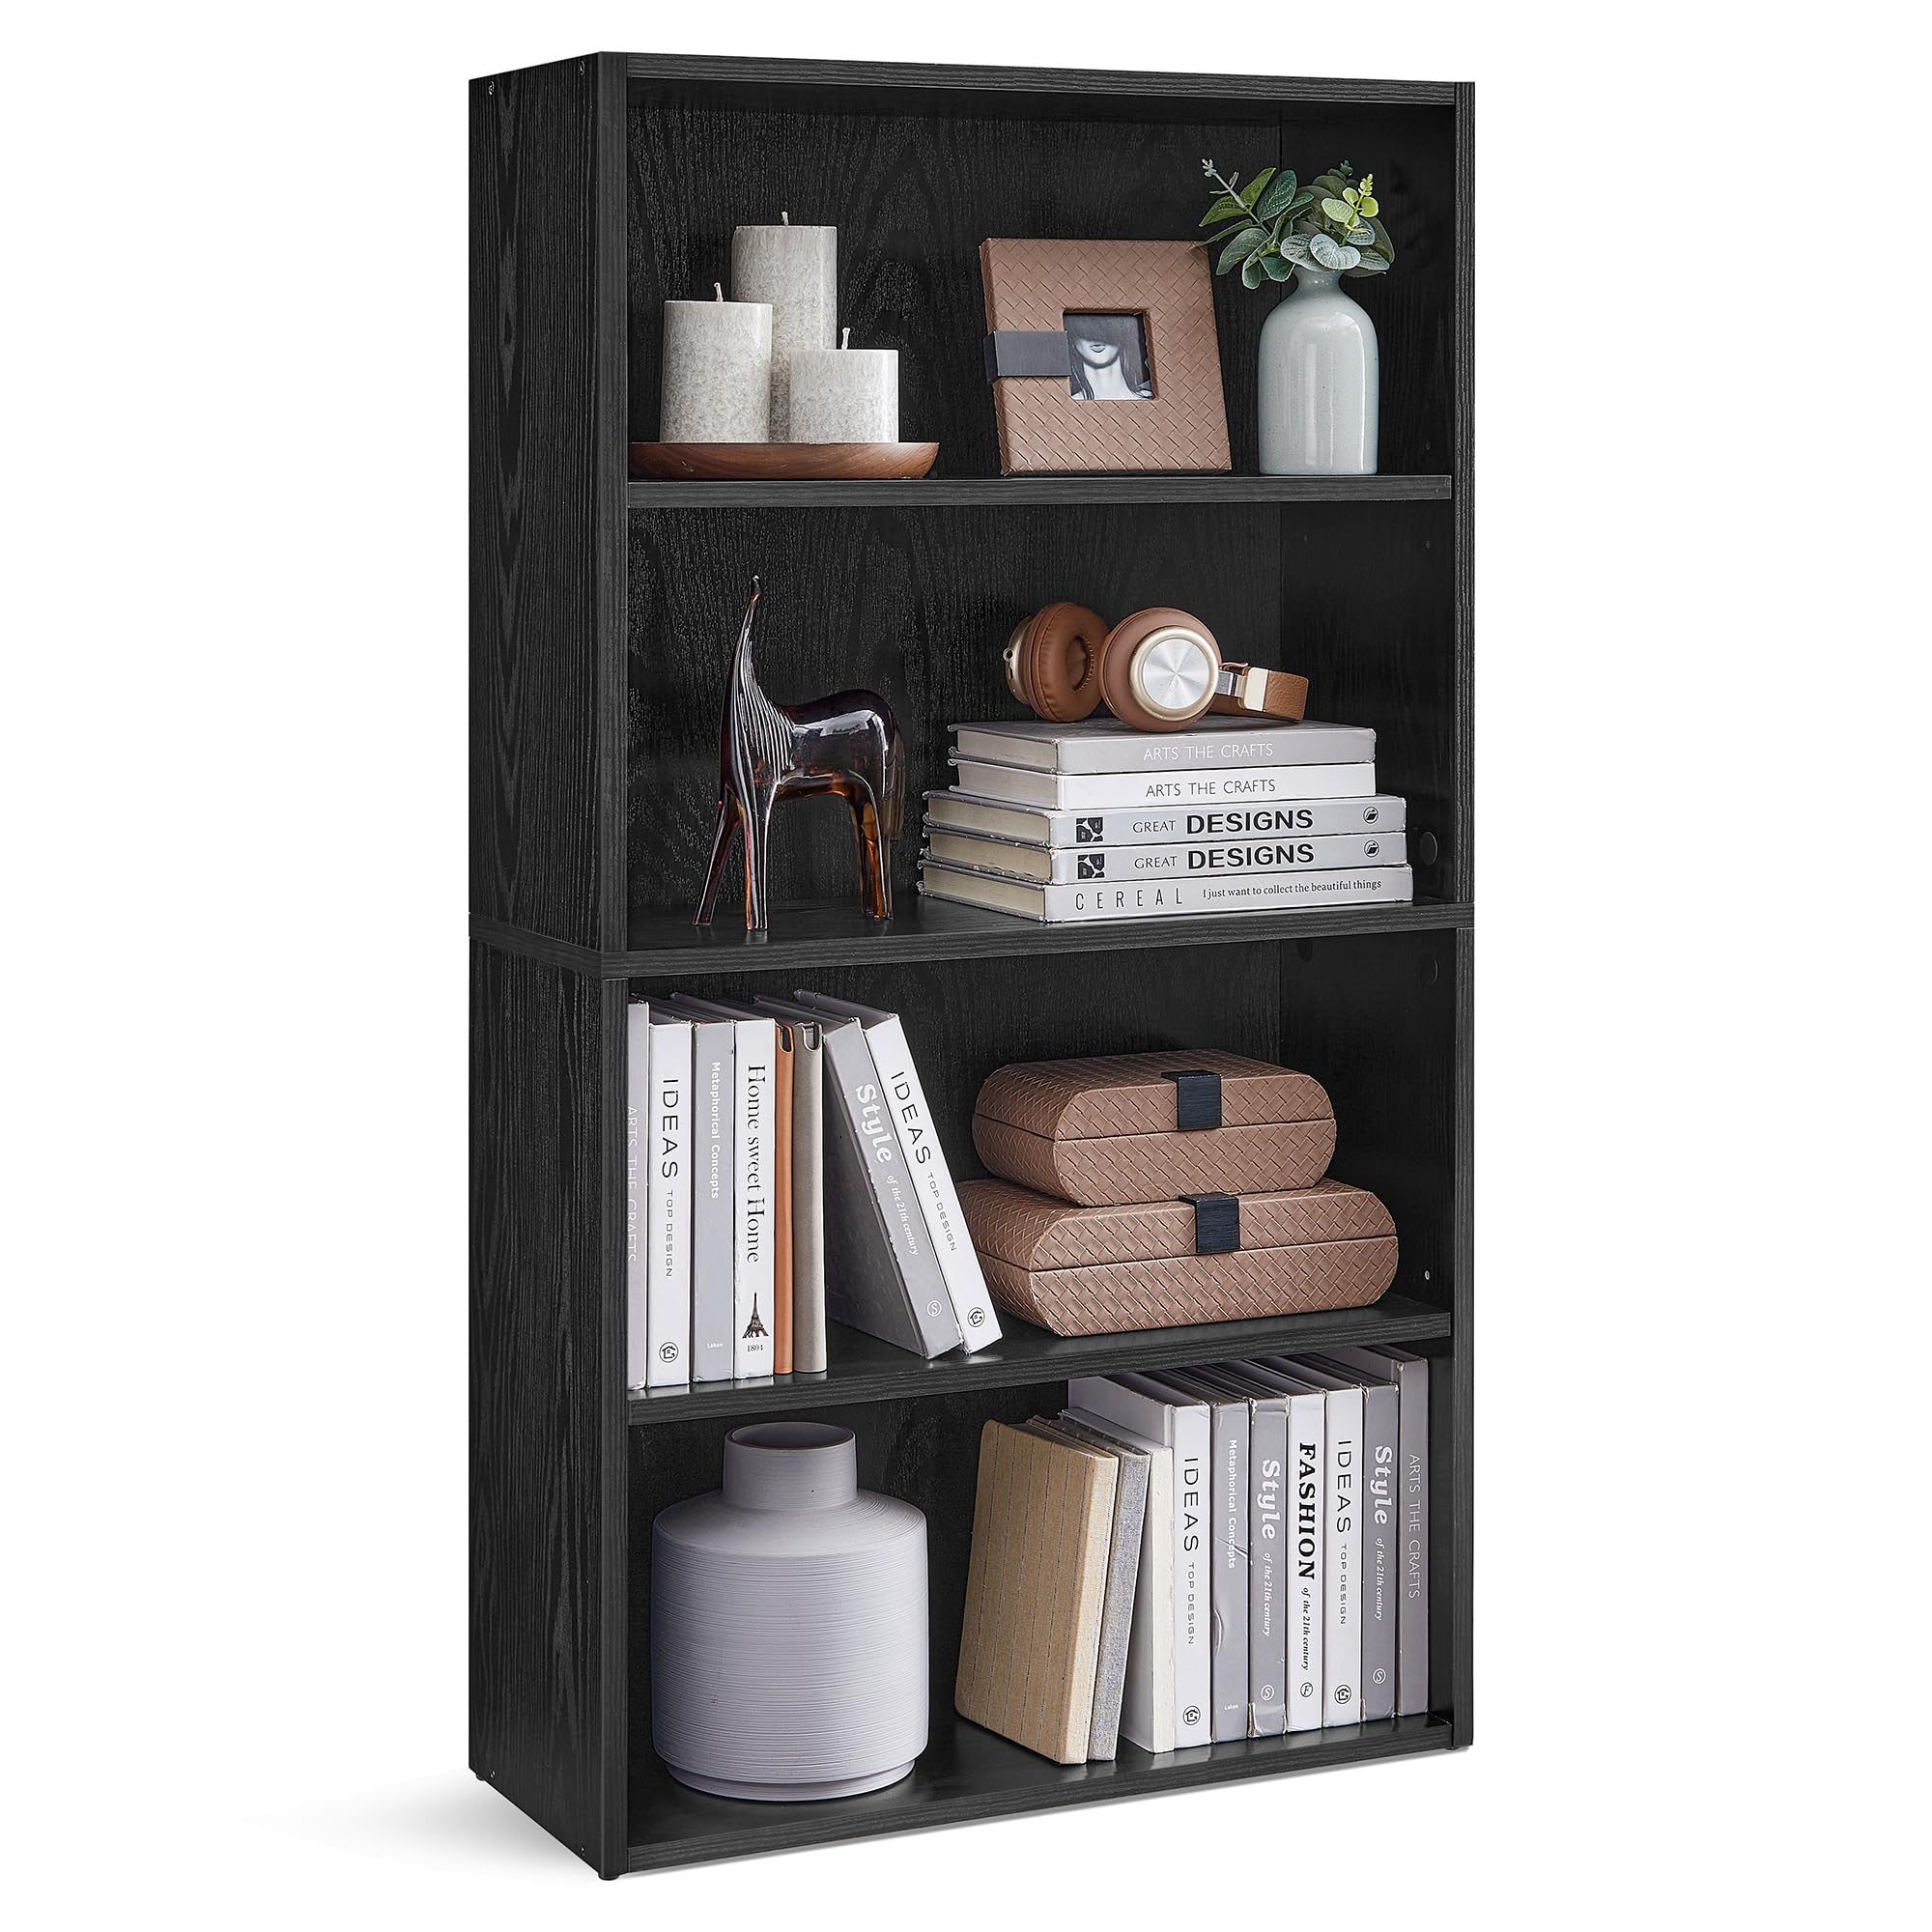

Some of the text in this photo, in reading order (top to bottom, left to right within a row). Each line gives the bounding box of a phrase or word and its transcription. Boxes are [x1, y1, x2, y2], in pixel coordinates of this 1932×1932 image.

[1144, 742, 1273, 760] ARTS THE CRAFTS
[1146, 779, 1276, 798] ARTS THE CRAFTS
[1132, 809, 1314, 836] GREAT DESIGNS
[1134, 842, 1315, 869] GREAT DESIGNS
[1075, 887, 1183, 911] CEREAL
[1203, 879, 1382, 900] I just want to collect the beautiful things
[662, 1078, 679, 1179] IDEAS
[710, 1062, 721, 1199] Metaphorical Concepts
[856, 1084, 892, 1162] Style
[892, 1071, 931, 1164] IDEAS
[628, 1106, 638, 1262] ARTS THE CRAFTS
[747, 1065, 766, 1264] Home sweet Home
[887, 1175, 919, 1256] of the 21th century
[928, 1172, 956, 1251] TOP DESIGN
[748, 1344, 763, 1352] 1804
[1183, 1457, 1199, 1552] IDEAS
[1228, 1438, 1237, 1570] Metaphorical Concepts
[1257, 1459, 1281, 1540] Style
[1298, 1442, 1316, 1579] FASHION
[1336, 1440, 1351, 1533] IDEAS
[1370, 1445, 1392, 1524] Style
[1375, 1538, 1384, 1548] of
[1408, 1454, 1420, 1600] ARTS THE CRAFTS
[1263, 1552, 1272, 1636] of the 21th century
[1301, 1587, 1311, 1598] of
[1375, 1587, 1383, 1621] century
